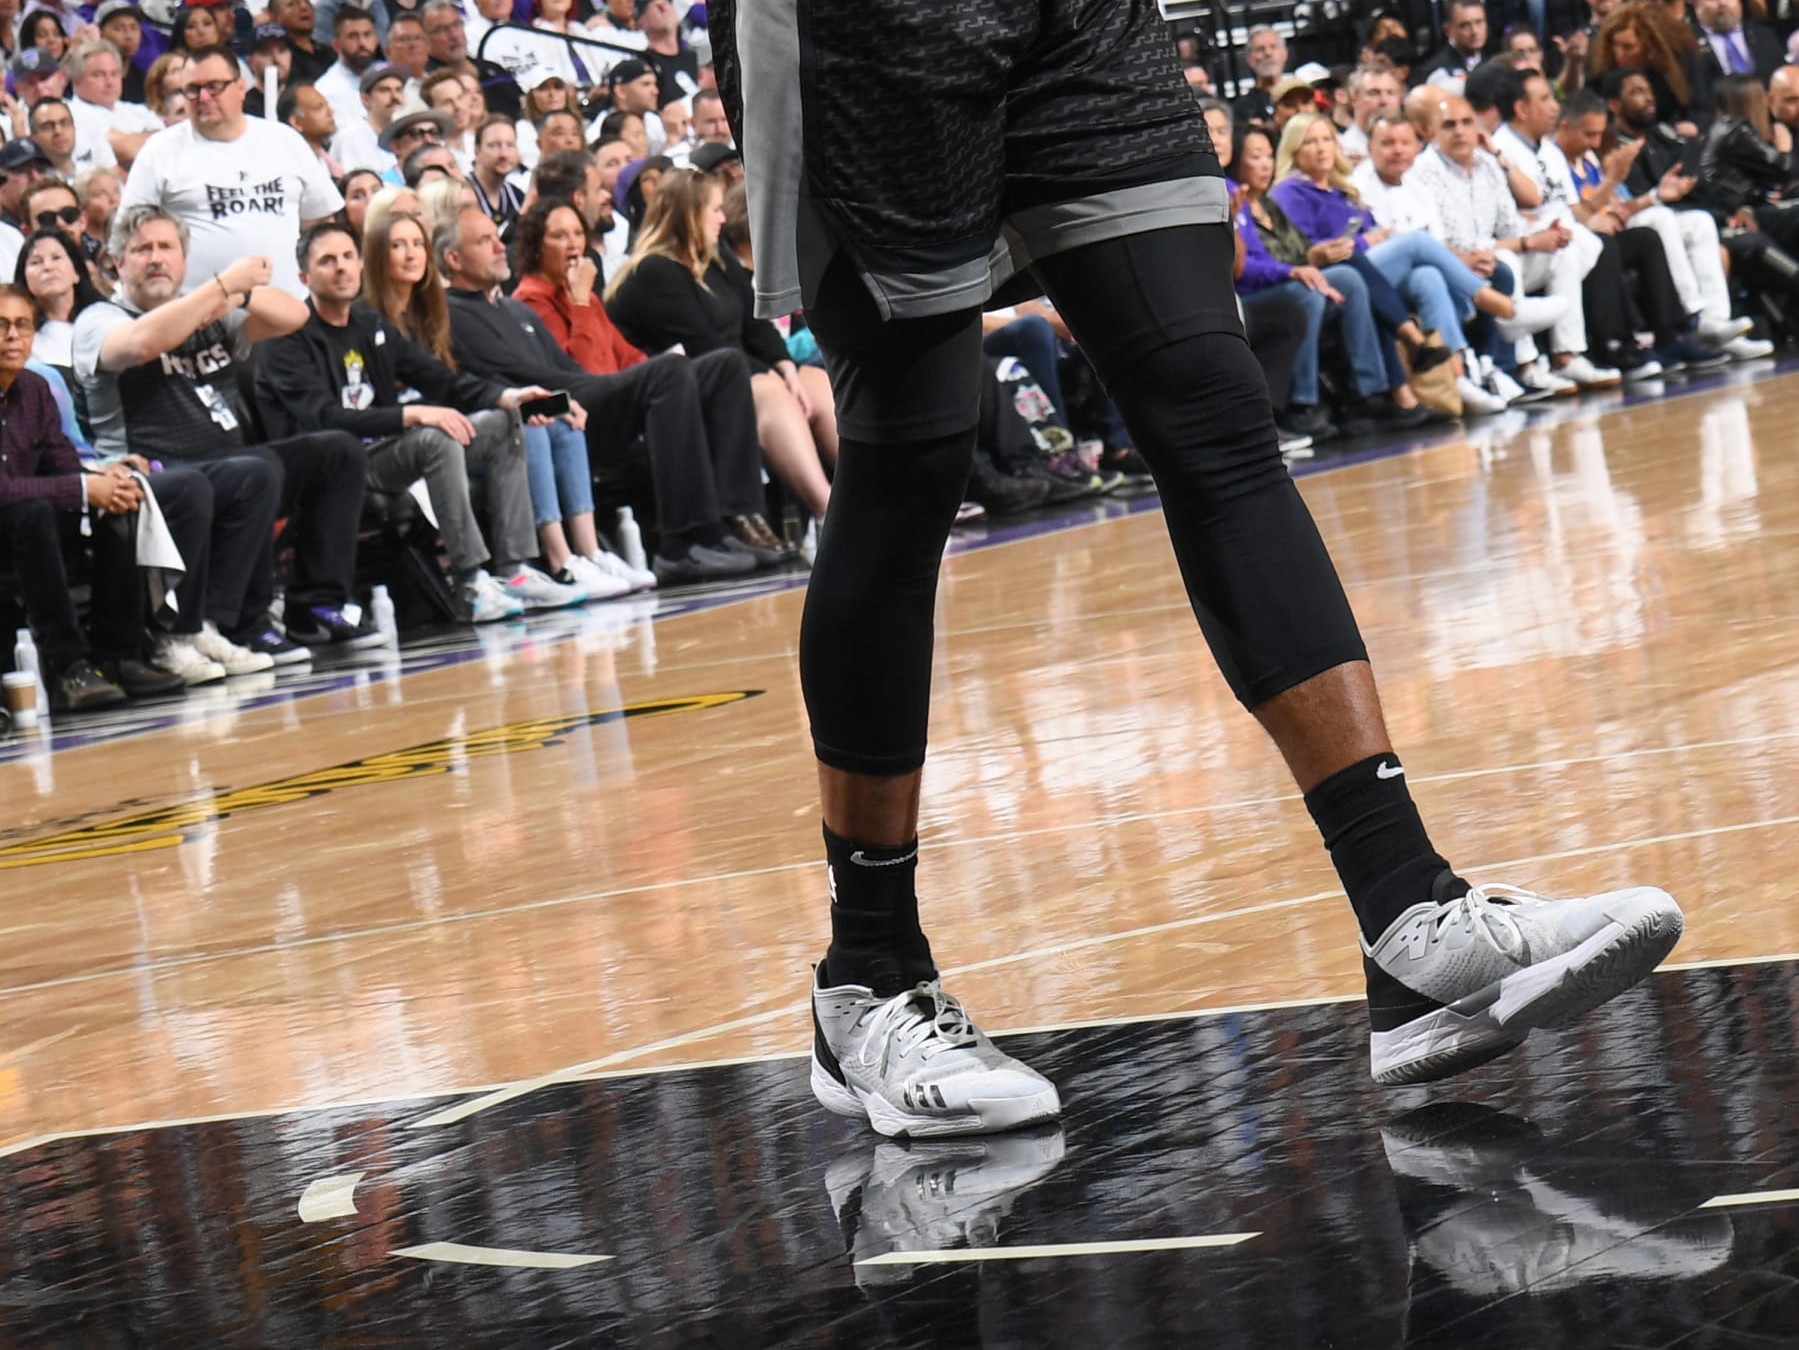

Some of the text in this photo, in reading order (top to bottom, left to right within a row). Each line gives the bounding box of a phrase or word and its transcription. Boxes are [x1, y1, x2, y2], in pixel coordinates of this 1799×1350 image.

[205, 176, 285, 202] FEEL THE
[210, 196, 285, 220] ROAR!
